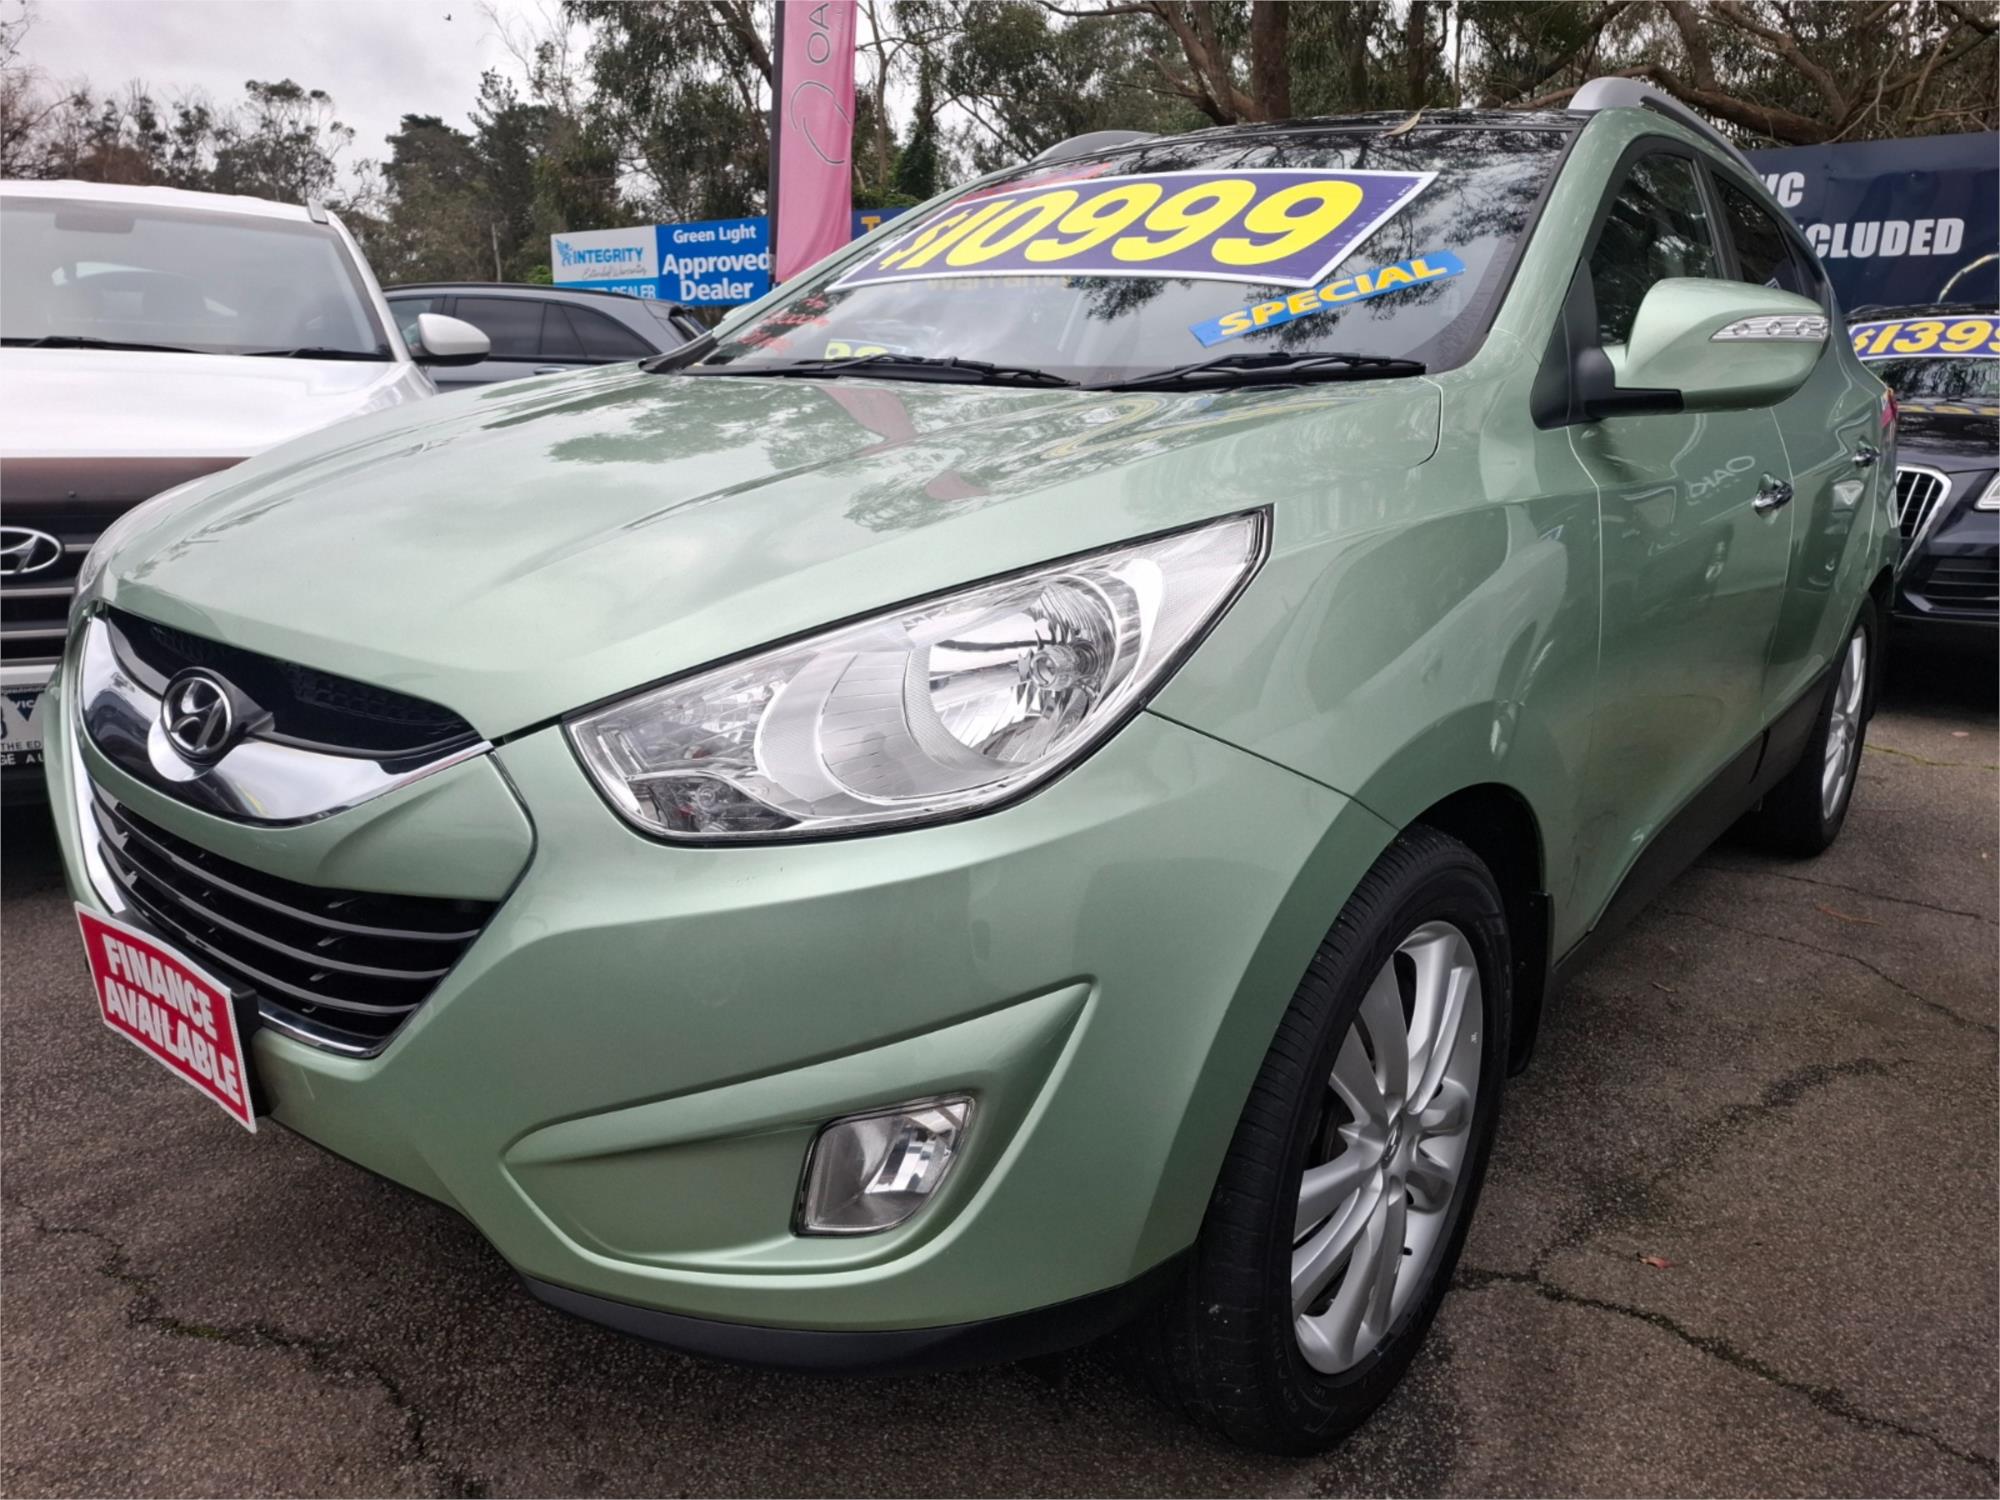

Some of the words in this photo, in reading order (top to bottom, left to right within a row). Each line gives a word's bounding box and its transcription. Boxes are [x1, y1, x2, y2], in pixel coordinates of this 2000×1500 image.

[673, 229, 716, 245] Green
[719, 224, 757, 244] Light
[880, 179, 1364, 271] $10999
[1801, 218, 1965, 259] CLUDED
[573, 247, 643, 264] INTEGRITY
[662, 247, 769, 281] Approved
[680, 277, 754, 301] Dealer
[1218, 258, 1448, 334] SPECIAL
[1, 742, 22, 752] THE
[102, 933, 218, 1041] FINANCE
[104, 976, 242, 1107] AVAILABLE
